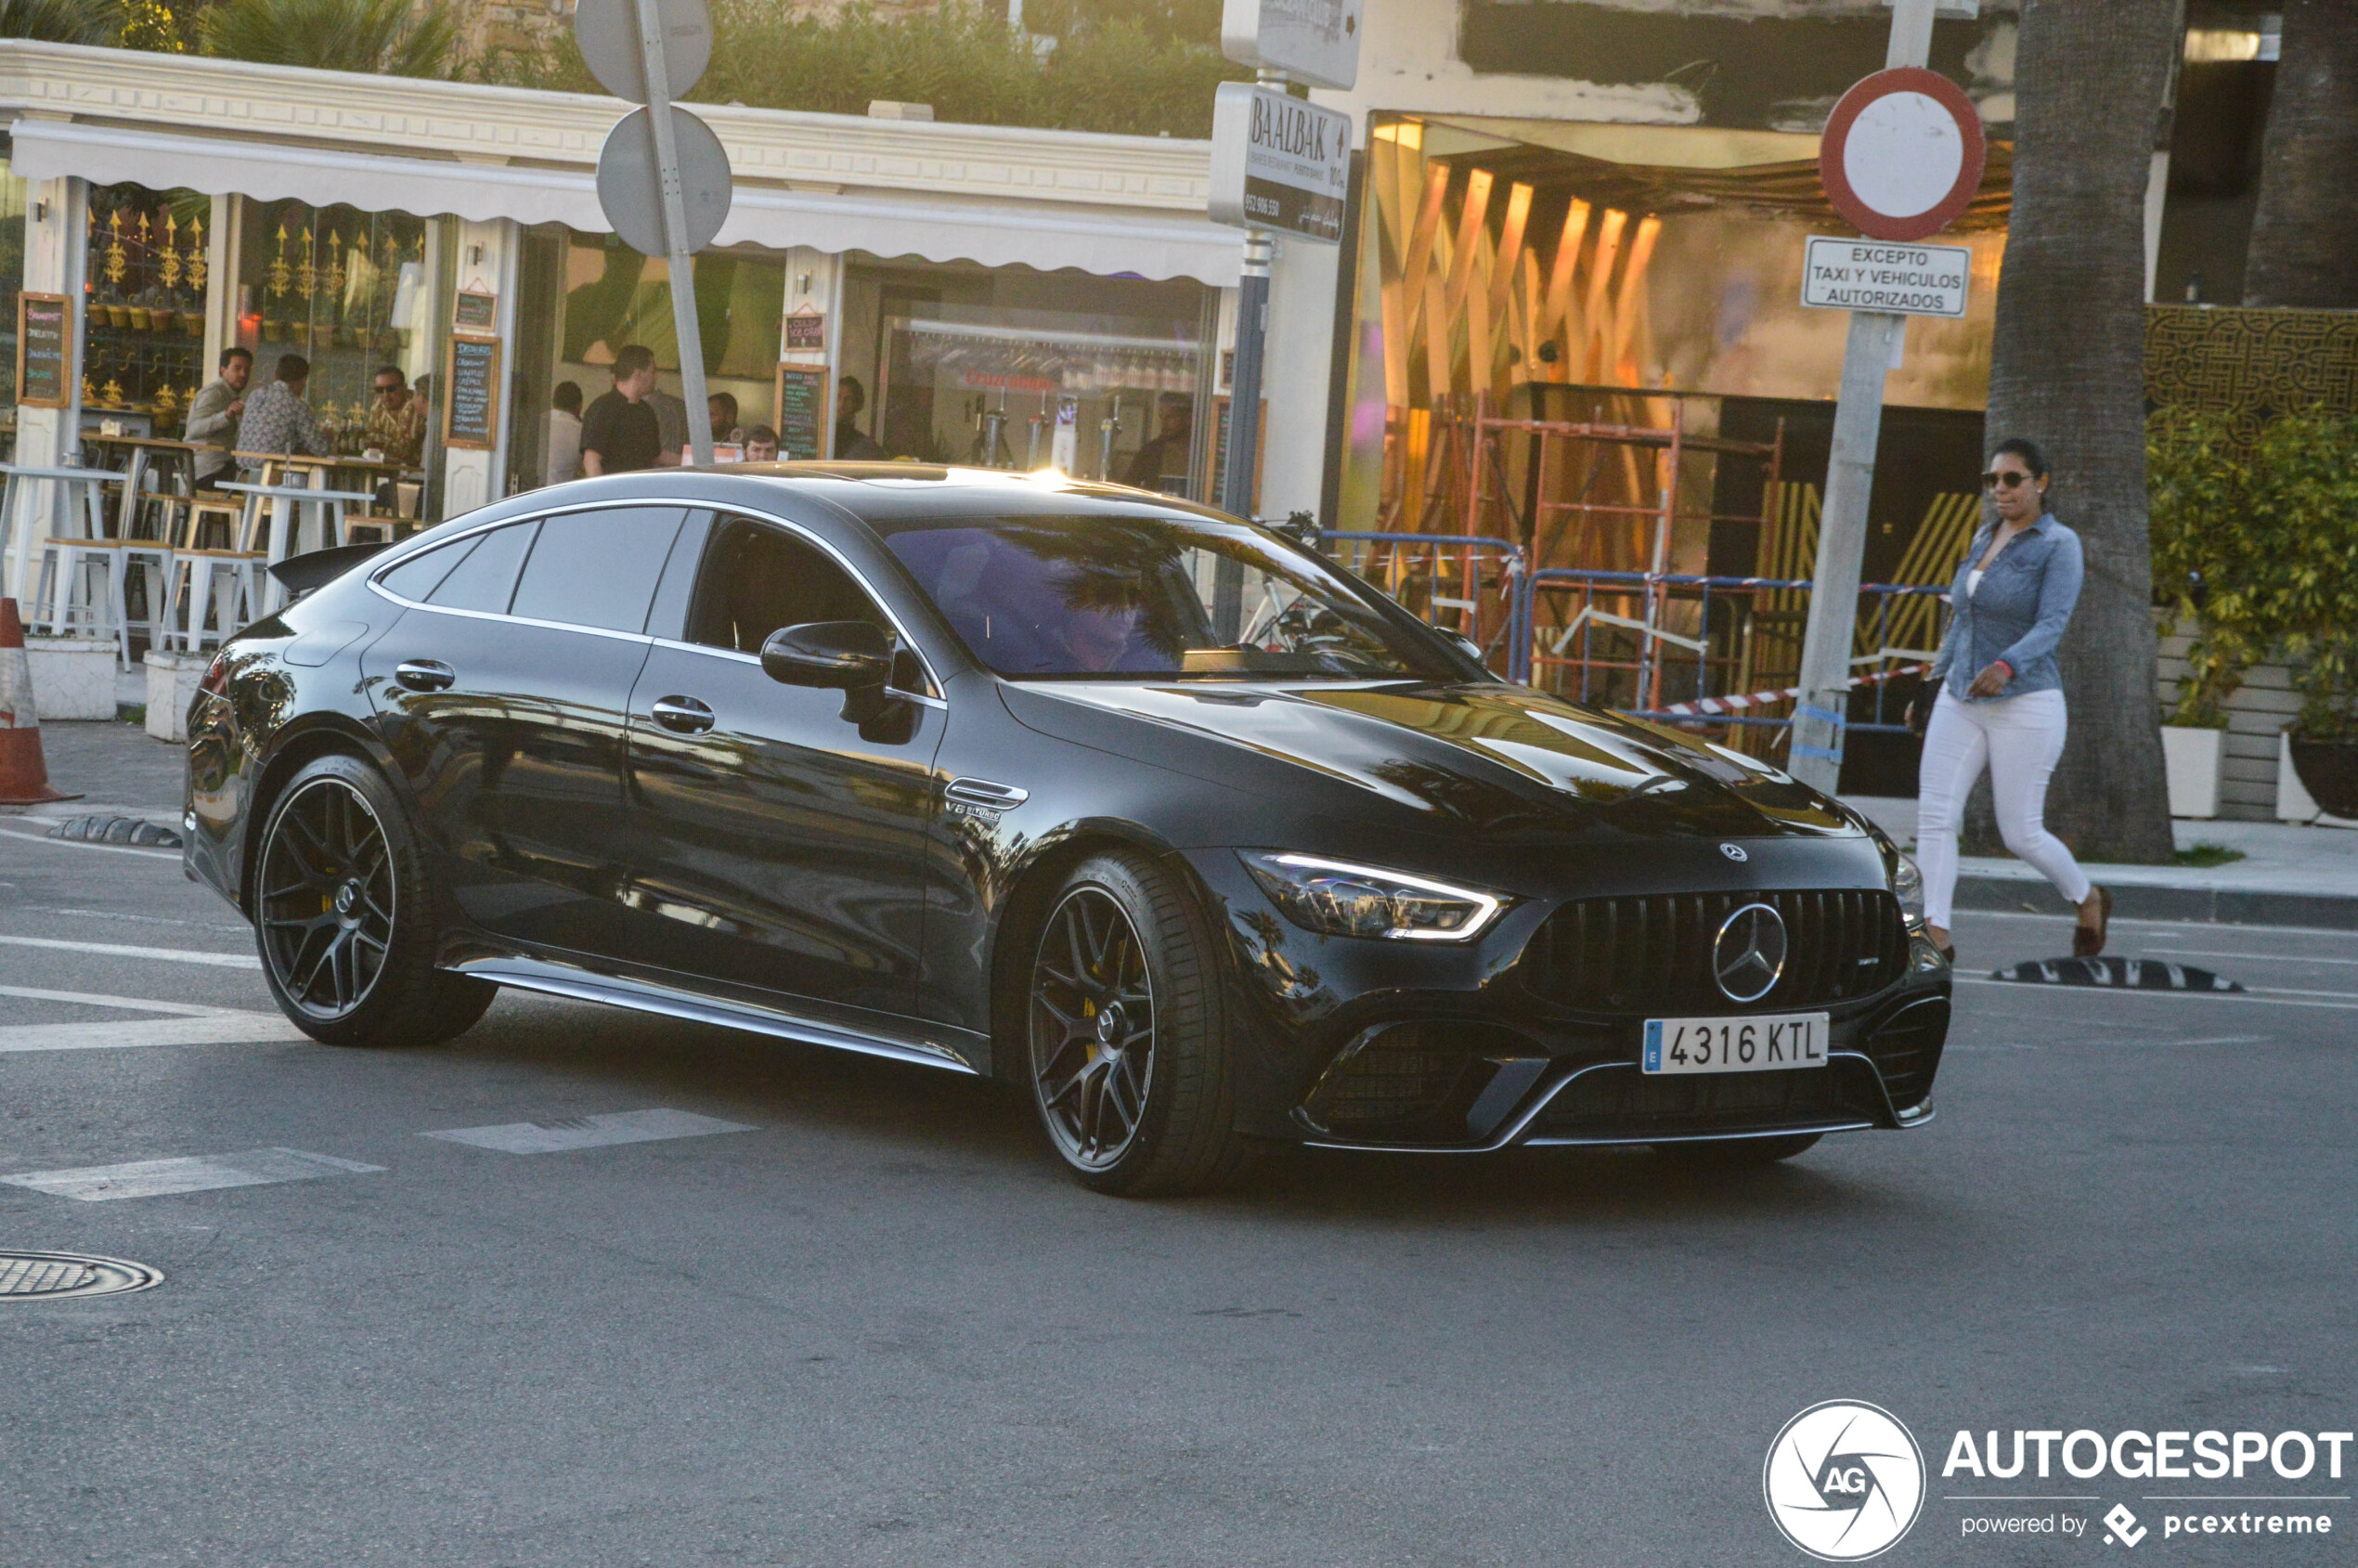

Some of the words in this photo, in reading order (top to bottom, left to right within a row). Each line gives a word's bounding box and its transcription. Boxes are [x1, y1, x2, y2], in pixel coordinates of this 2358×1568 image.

[1250, 97, 1328, 162] BAALBAK
[1245, 193, 1257, 212] 952
[1852, 248, 1928, 266] EXCEPTO
[1813, 266, 1850, 281] TAXI
[1856, 269, 1867, 282] Y
[1871, 270, 1962, 289] VEHICULOS
[1826, 289, 1944, 309] AUTORIZADOS
[965, 369, 1054, 391] Cruzcampo
[945, 801, 965, 814] V8
[966, 806, 1001, 821] BITURBO
[1669, 1025, 1756, 1066] 4316
[1768, 1021, 1820, 1062] KTL
[1649, 1051, 1656, 1063] E
